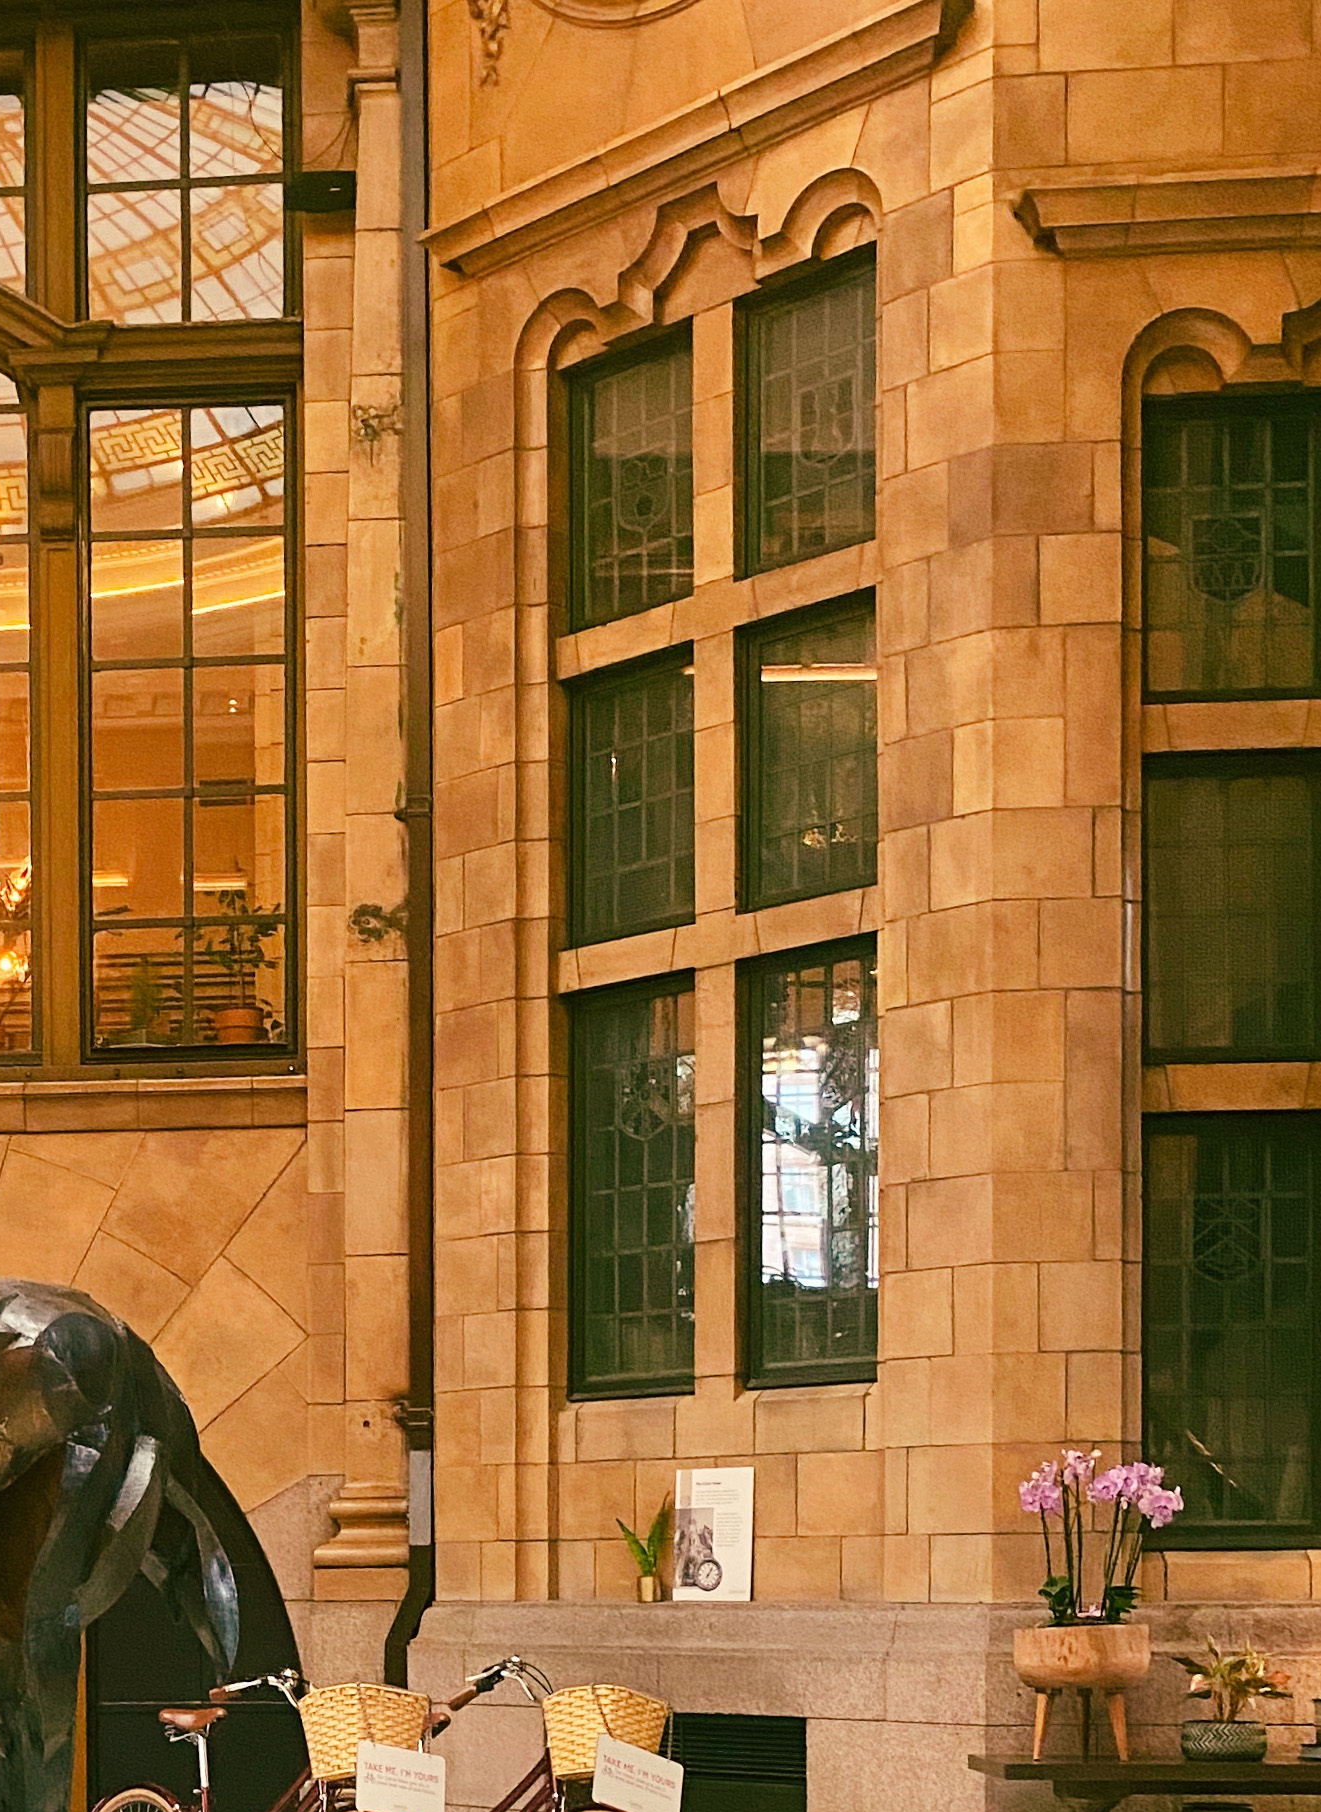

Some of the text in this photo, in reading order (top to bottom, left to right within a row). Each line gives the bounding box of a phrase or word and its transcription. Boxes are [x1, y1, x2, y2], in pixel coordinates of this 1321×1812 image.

[364, 1761, 384, 1774] TAKE
[413, 1771, 440, 1784] YOURS
[602, 1753, 622, 1769] TAKE
[650, 1773, 676, 1790] YOURS
